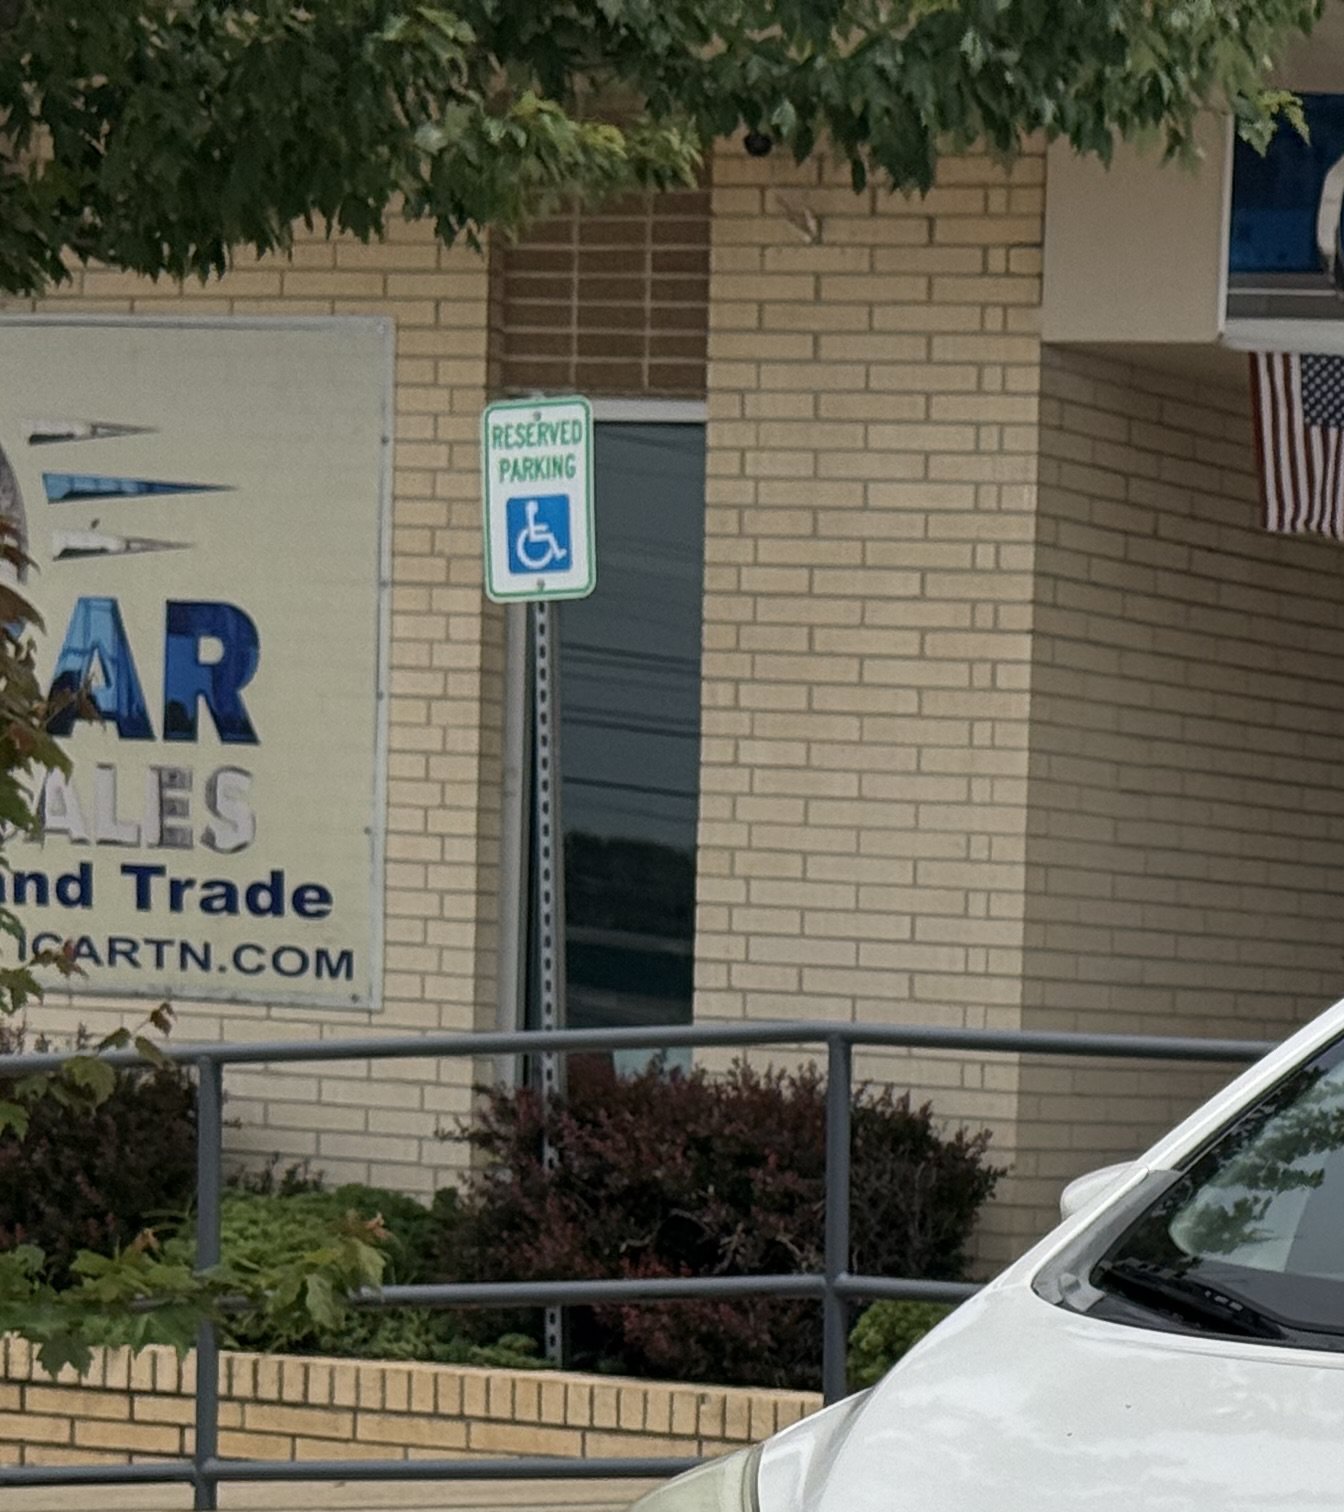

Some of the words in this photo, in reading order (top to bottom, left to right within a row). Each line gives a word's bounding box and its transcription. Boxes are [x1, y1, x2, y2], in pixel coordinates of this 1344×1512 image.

[492, 420, 582, 450] RESERVED
[498, 454, 576, 483] PARKING
[44, 596, 261, 746] AR
[36, 761, 256, 854] ALES
[0, 861, 94, 910] nd
[121, 863, 333, 919] Trade
